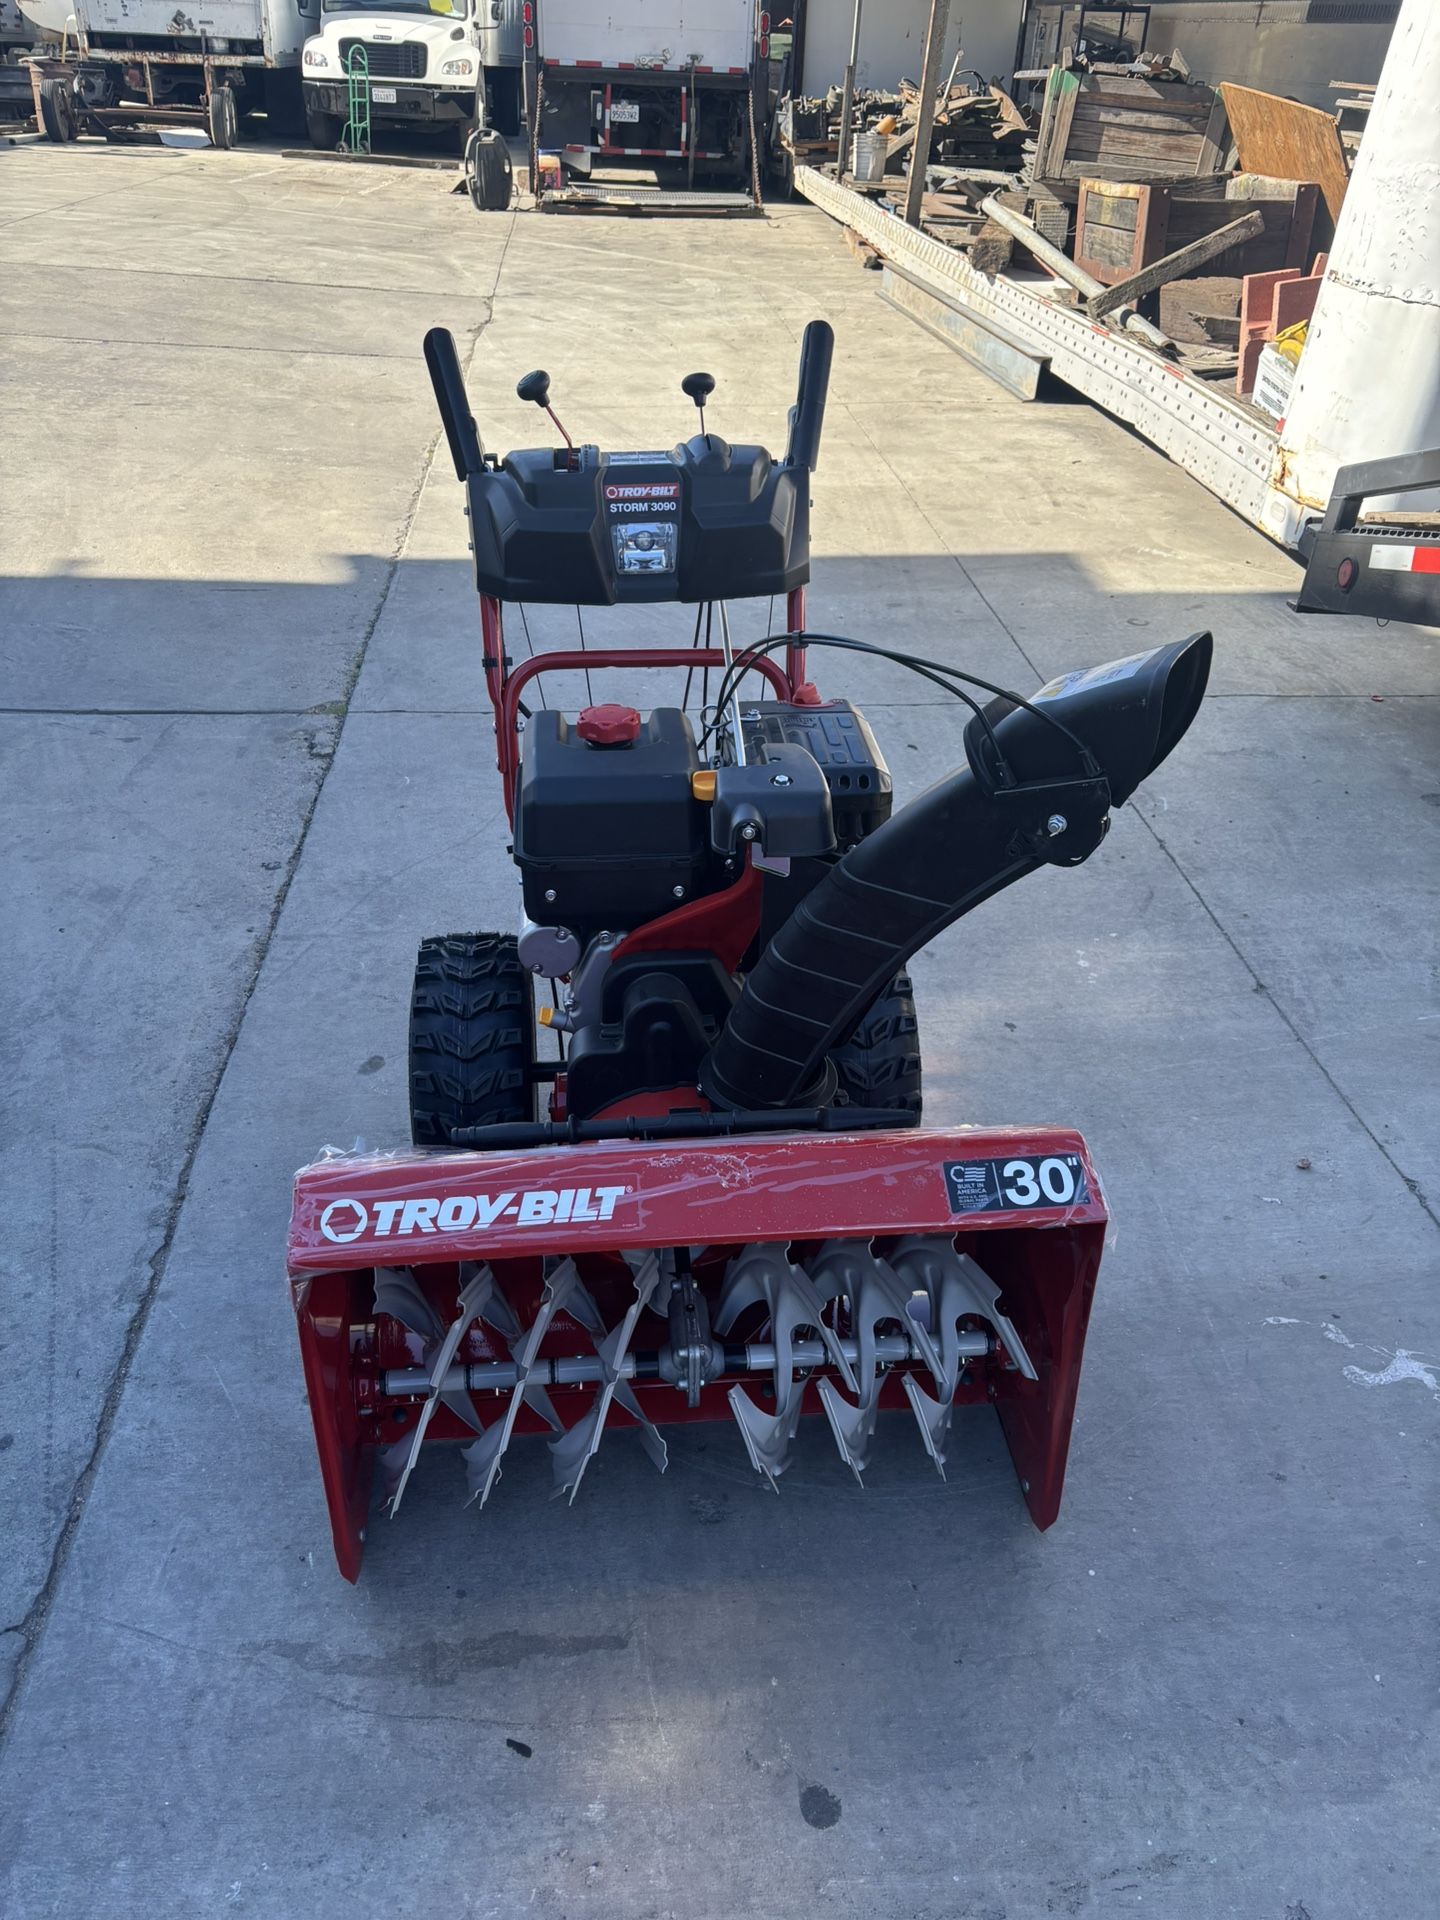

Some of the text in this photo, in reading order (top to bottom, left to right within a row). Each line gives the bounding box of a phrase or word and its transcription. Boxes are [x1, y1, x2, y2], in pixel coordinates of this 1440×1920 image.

[617, 486, 678, 497] TROY-BILT
[609, 501, 677, 513] STORM 3090
[1003, 1157, 1078, 1206] 30"
[372, 1185, 627, 1237] TROY-BILT
